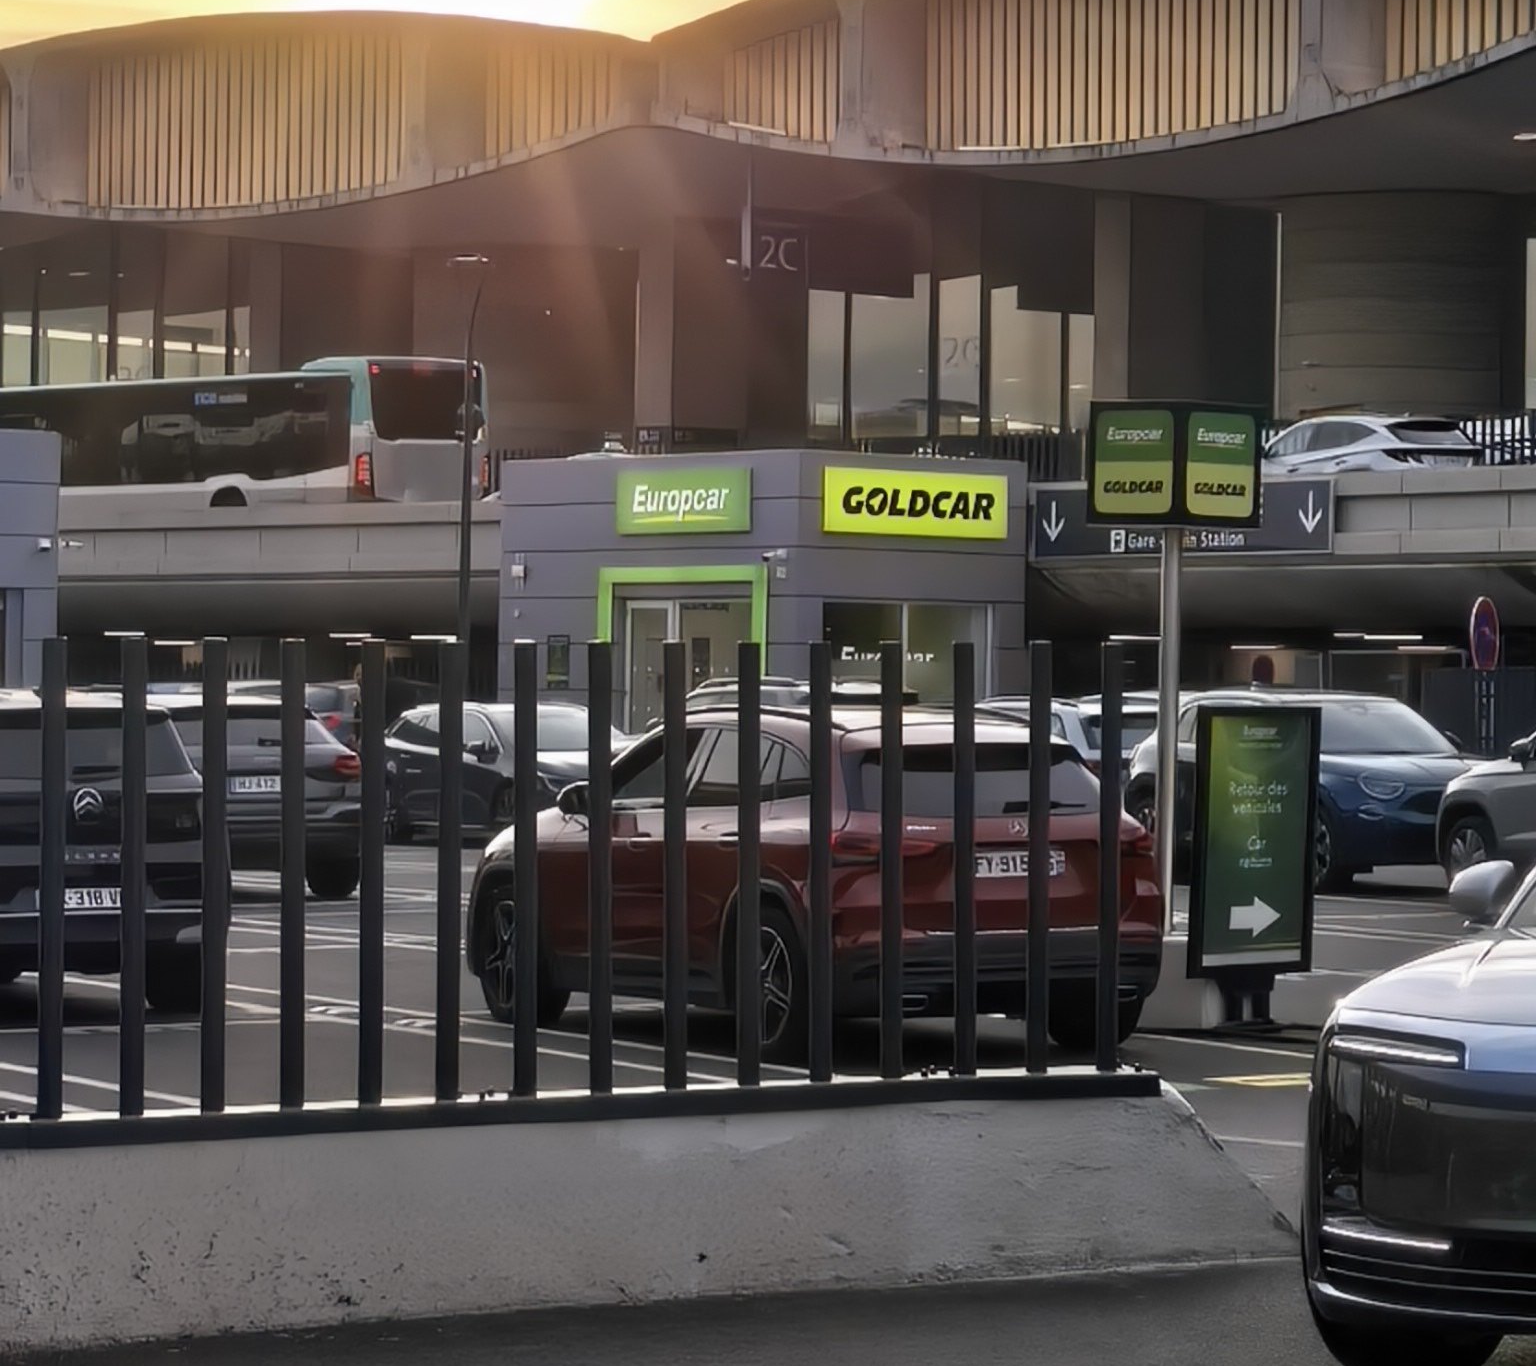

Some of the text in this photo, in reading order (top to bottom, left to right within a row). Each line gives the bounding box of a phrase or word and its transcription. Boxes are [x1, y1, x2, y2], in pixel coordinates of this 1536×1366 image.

[759, 236, 798, 271] 2C
[1107, 427, 1163, 443] Europcar
[1197, 428, 1246, 444] Europcar
[1103, 481, 1164, 494] GOLDCAR
[632, 484, 731, 522] Europcar
[842, 485, 995, 521] GOLDCAR
[1128, 533, 1156, 549] Gare
[1200, 531, 1245, 548] Station
